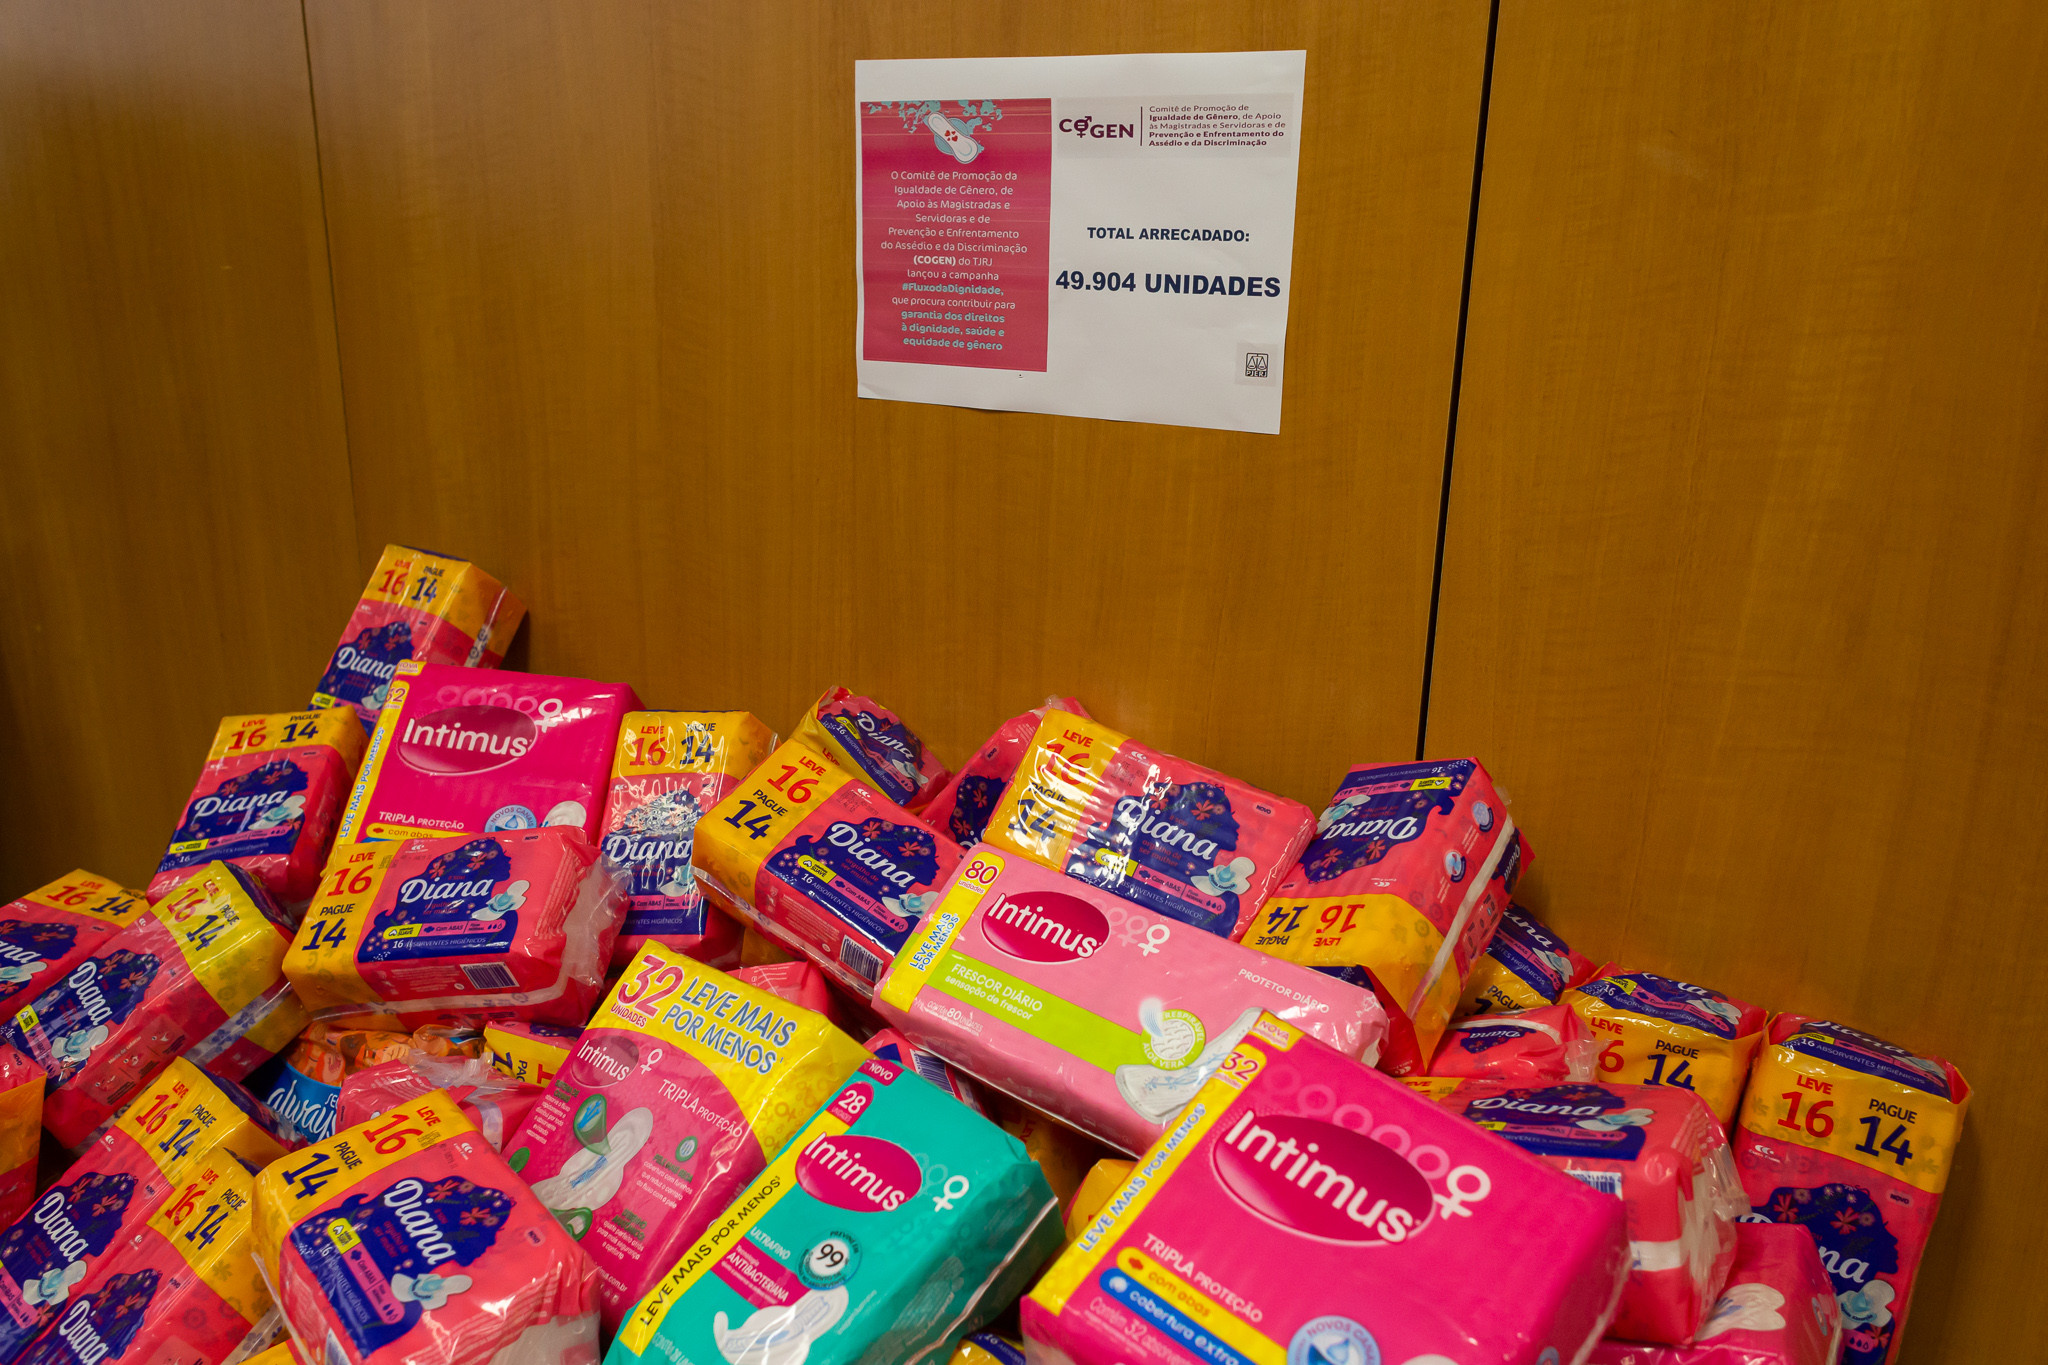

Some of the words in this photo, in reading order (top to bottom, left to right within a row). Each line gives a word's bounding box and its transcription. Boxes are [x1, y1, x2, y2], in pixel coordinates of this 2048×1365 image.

[1194, 104, 1236, 113] Promoção
[1206, 113, 1240, 121] Gênero,
[1255, 113, 1281, 121] Apoio
[1150, 131, 1194, 139] Prevenção
[1160, 122, 1210, 130] Magistradas
[1204, 139, 1267, 147] Discriminação
[895, 186, 942, 195] Igualdade
[945, 186, 956, 194] de
[959, 186, 998, 196] Gênero,
[1001, 187, 1013, 195] de
[901, 171, 935, 180] Comitê
[938, 172, 950, 180] de
[953, 171, 1002, 182] Promoção
[1005, 172, 1017, 180] da
[897, 200, 925, 210] Apoio
[927, 200, 938, 208] às
[941, 200, 1001, 210] Magistradas
[916, 214, 966, 222] Servidoras
[978, 215, 990, 223] de
[889, 228, 936, 237] Prevenção
[947, 229, 1019, 238] Enfrentamento
[1087, 227, 1134, 239] TOTAL
[1139, 228, 1250, 242] ARRECADADO:
[881, 242, 893, 250] do
[895, 242, 932, 250] Assédio
[943, 243, 955, 251] da
[957, 243, 1027, 254] Discriminação
[913, 255, 956, 266] (COGEN)
[959, 257, 970, 265] do
[973, 258, 992, 266] TJRJ
[903, 283, 1004, 295] #FluxodaDignidade,
[907, 270, 939, 280] lançou
[949, 271, 999, 282] campanha
[1056, 270, 1136, 291] 49.904
[1145, 273, 1281, 297] UNIDADES
[892, 297, 909, 305] que
[911, 298, 945, 306] procura
[948, 299, 992, 308] contribuir
[994, 302, 1015, 310] para
[902, 311, 942, 320] garantia
[945, 312, 962, 320] dos
[965, 313, 1005, 322] direitos
[902, 323, 907, 331] à
[909, 324, 963, 335] dignidade,
[966, 327, 996, 336] saúde
[903, 337, 950, 347] equidade
[967, 341, 1003, 350] gênero
[337, 647, 395, 680] Diana
[289, 712, 322, 721] PAGUE
[228, 726, 267, 750] 16
[280, 721, 319, 743] 14
[402, 718, 528, 757] Intimus
[1063, 729, 1093, 748] LEVE
[798, 756, 827, 777] LEVE
[768, 764, 819, 803] 16
[194, 790, 286, 818] Diana
[752, 789, 788, 817] PAGUE
[379, 812, 415, 824] TRIPLA
[417, 818, 464, 829] PROTEÇÃO
[724, 800, 774, 840] 14
[1117, 798, 1220, 861] Diana
[1323, 817, 1418, 840] Diana
[349, 853, 375, 864] LEVE
[828, 824, 914, 888] Diana
[327, 865, 374, 897] 16
[964, 860, 999, 885] 80
[400, 877, 494, 903] Diana
[801, 873, 813, 884] 16
[812, 882, 852, 912] ABSORVENTES
[852, 910, 885, 934] HIGIÊNICOS
[166, 887, 208, 923] 16
[320, 903, 356, 916] PAGUE
[1268, 906, 1309, 934] 14
[1316, 904, 1365, 933] 16
[185, 914, 222, 951] 14
[302, 919, 348, 951] 14
[988, 894, 1098, 958] Intimus
[617, 954, 685, 1019] 32
[945, 974, 986, 998] sensação
[987, 992, 999, 1004] de
[1000, 998, 1033, 1020] frescor
[951, 963, 1002, 993] FRESCOR
[1002, 986, 1043, 1012] DIÁRIO
[1238, 968, 1292, 997] PROTETOR
[1292, 991, 1330, 1014] DIÁRIO
[610, 1003, 648, 1027] UNIDADES
[680, 977, 740, 1019] LEVE
[729, 1006, 797, 1048] MAIS
[662, 1004, 707, 1041] POR
[700, 1027, 778, 1075] MENOS
[1656, 1039, 1699, 1059] PAGUE
[577, 1040, 630, 1081] Intimus
[870, 1062, 893, 1080] NOVO
[1221, 1052, 1259, 1081] 32
[657, 1079, 698, 1112] TRIPLA
[697, 1109, 743, 1138] PROTEÇÃO
[838, 1090, 867, 1115] 28
[1797, 1075, 1833, 1095] LEVE
[1868, 1099, 1918, 1124] PAGUE
[135, 1094, 178, 1135] 16
[158, 1118, 201, 1162] 14
[416, 1105, 442, 1127] LEVE
[1777, 1091, 1835, 1138] 16
[1854, 1115, 1914, 1166] 14
[362, 1113, 424, 1155] 16
[334, 1140, 363, 1170] PAGUE
[281, 1152, 339, 1200] 14
[805, 1133, 904, 1212] Intimus
[1224, 1110, 1414, 1243] Intimus
[35, 1192, 90, 1262] Diana
[165, 1183, 205, 1226] 16
[185, 1203, 229, 1250] 14
[383, 1179, 457, 1265] Diana
[640, 1284, 674, 1326] LEVE
[673, 1244, 712, 1284] MAIS
[711, 1219, 739, 1245] POR
[737, 1183, 777, 1223] MENOS
[750, 1226, 791, 1260] ULTRAFINO
[727, 1252, 789, 1302] ANTIBACTERIANA
[1143, 1233, 1195, 1278] TRIPLA
[1194, 1271, 1263, 1322] PROTEÇÃO
[1130, 1291, 1195, 1340] cobertura
[1195, 1335, 1240, 1365] extra
